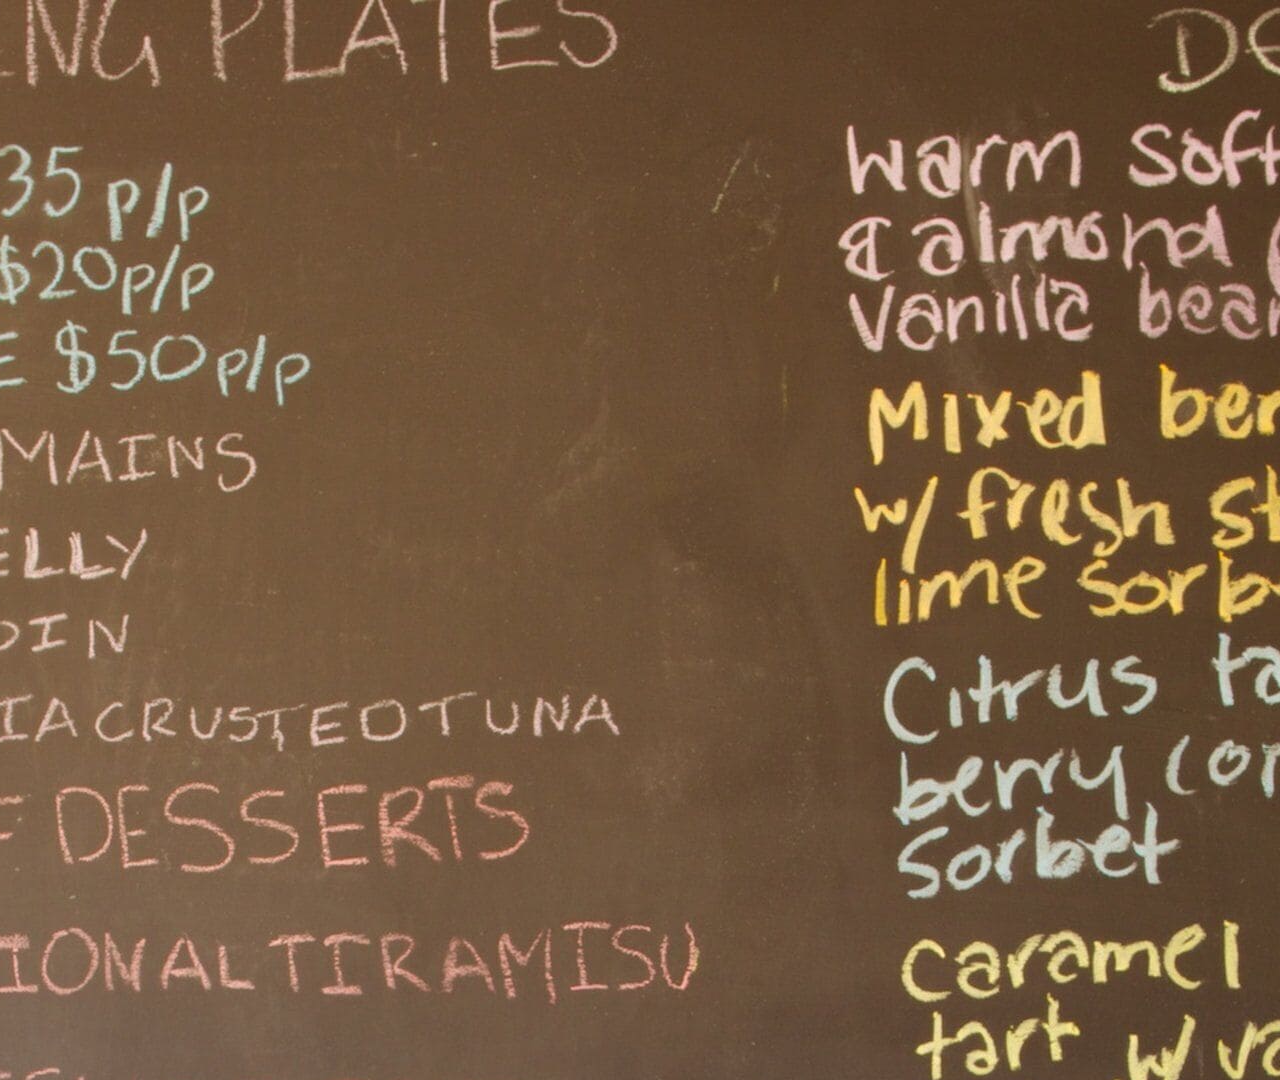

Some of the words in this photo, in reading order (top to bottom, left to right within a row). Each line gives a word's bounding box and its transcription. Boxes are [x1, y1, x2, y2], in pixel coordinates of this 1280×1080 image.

[911, 202, 1232, 275] almond
[965, 467, 1176, 555] fresh
[874, 555, 1047, 626] lime
[884, 655, 1157, 744] Citrus
[55, 775, 530, 872] DESSERTS
[893, 746, 1130, 825] berry
[898, 802, 1180, 898] sorbet
[268, 921, 700, 1004] TIRAMISU
[915, 992, 1080, 1080] tart
